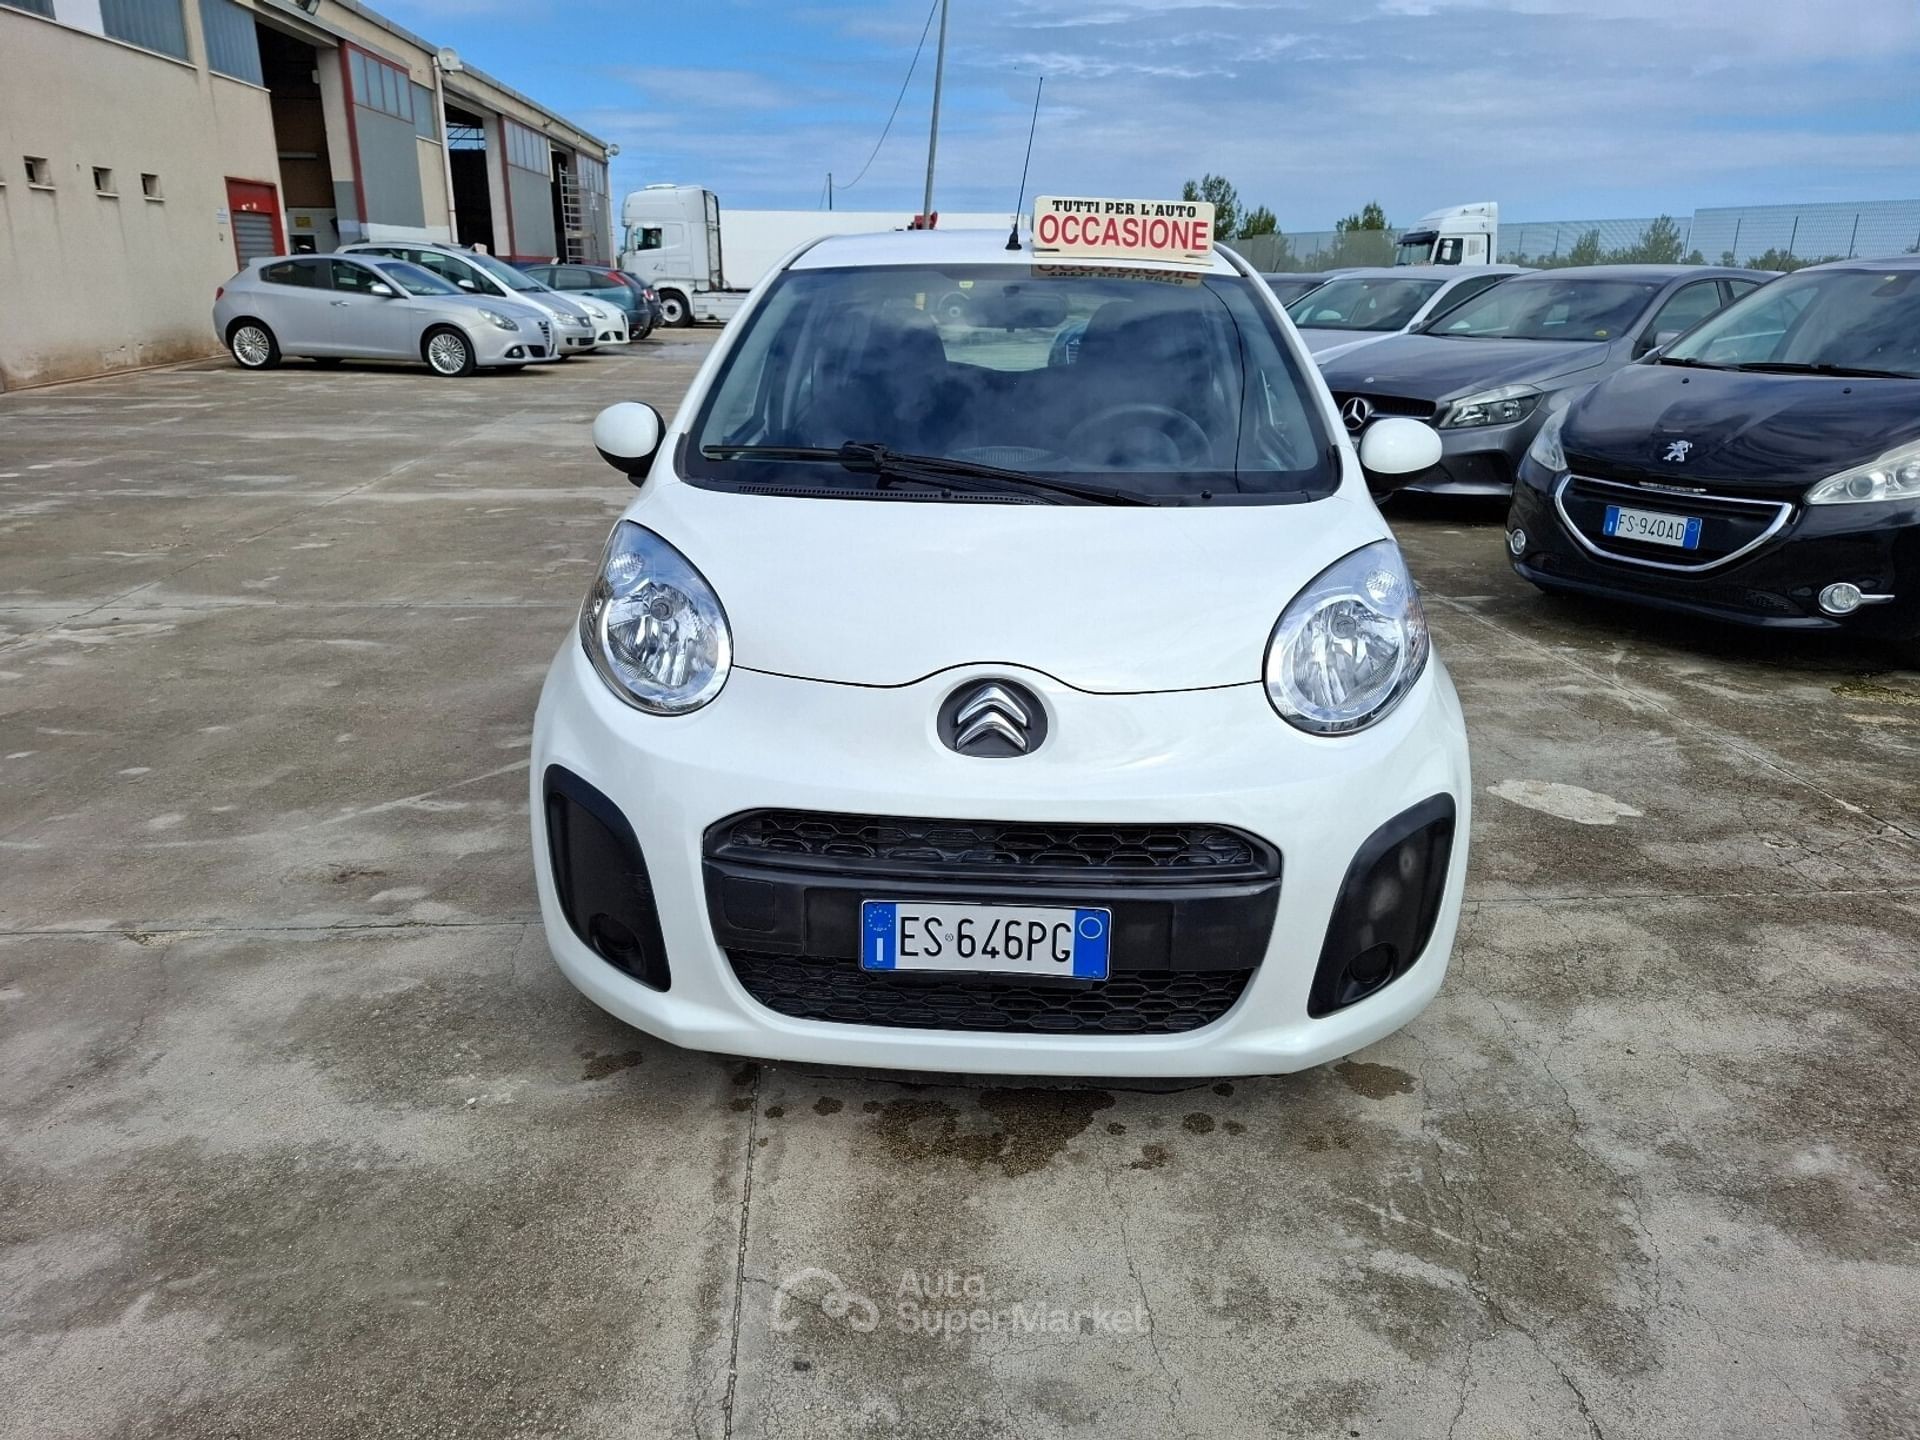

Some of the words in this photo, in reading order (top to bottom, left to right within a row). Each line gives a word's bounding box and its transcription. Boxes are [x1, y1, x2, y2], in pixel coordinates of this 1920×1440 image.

[1052, 200, 1100, 213] TUTTI
[1104, 202, 1135, 215] PER
[1141, 204, 1197, 218] L'AUTO
[1039, 214, 1209, 251] OCCASIONE
[1618, 514, 1635, 533] FS
[1639, 517, 1685, 541] 940AD
[900, 916, 943, 957] ES
[956, 918, 1072, 963] 646PG
